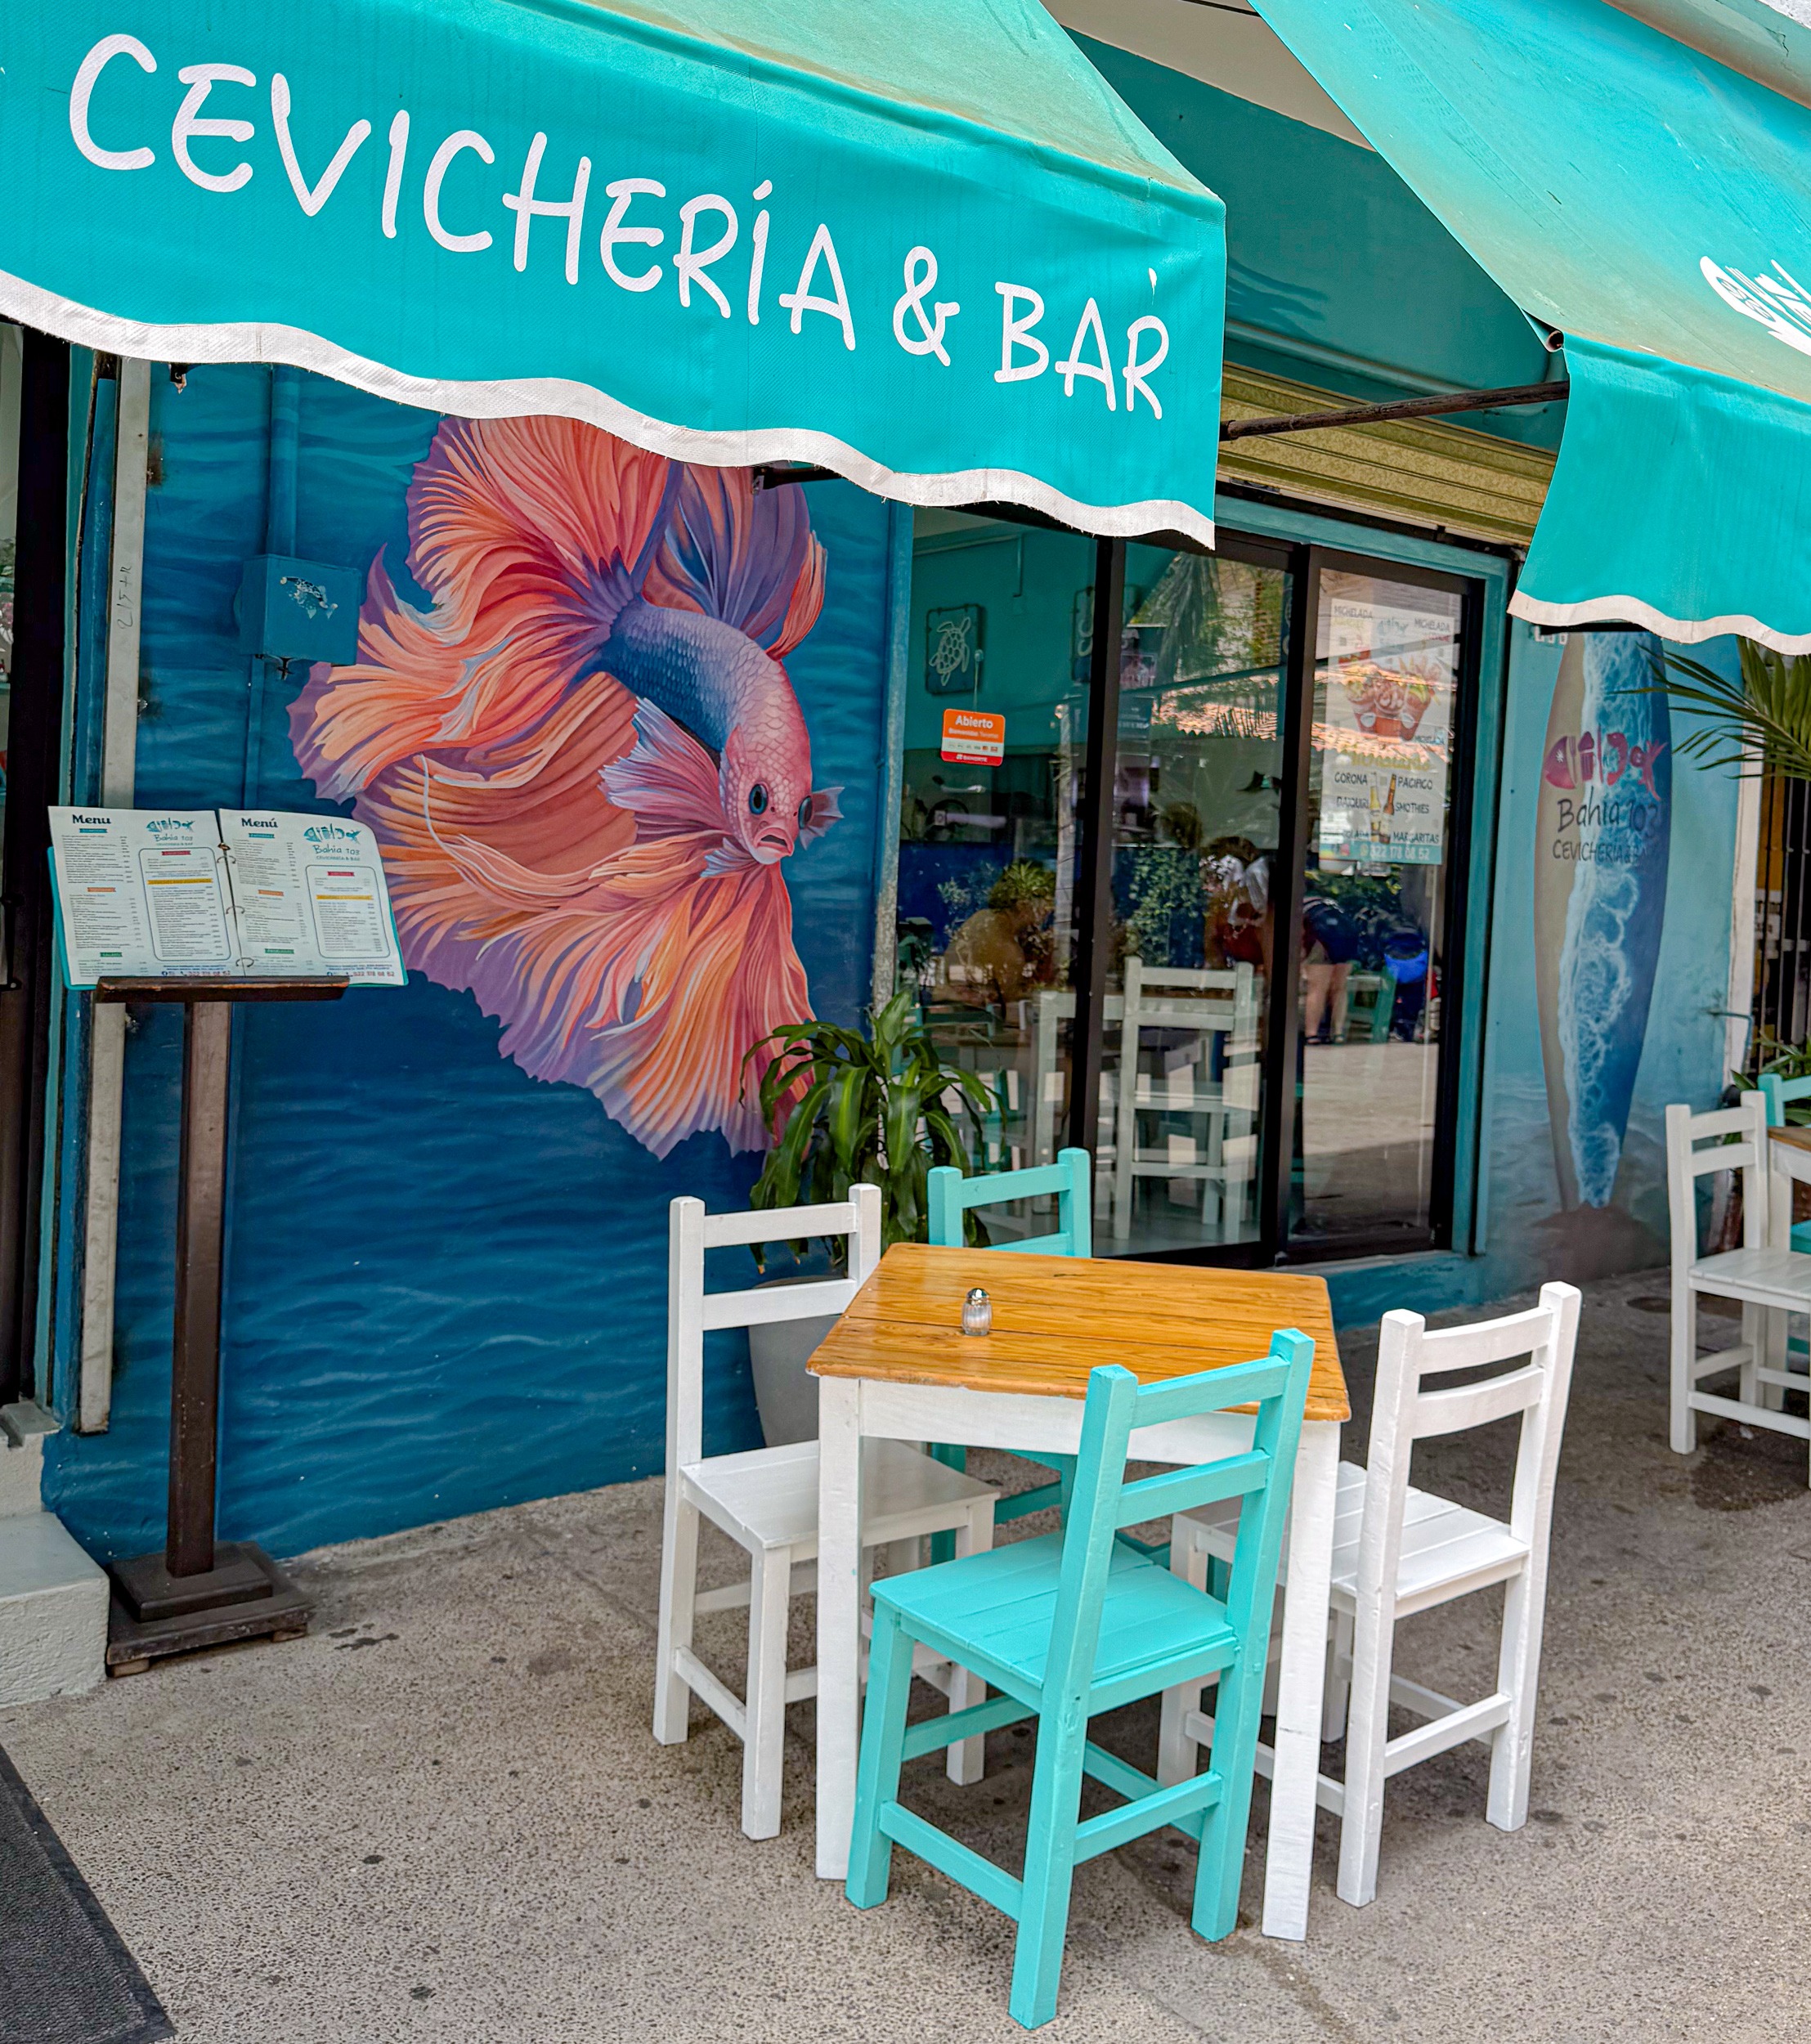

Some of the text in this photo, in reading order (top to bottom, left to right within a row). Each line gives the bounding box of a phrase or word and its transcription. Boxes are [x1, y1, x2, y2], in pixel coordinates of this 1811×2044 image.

[69, 34, 1170, 419] CEVICHERÍA & BAR
[1334, 605, 1373, 619] MICHELADA
[1414, 618, 1450, 632] MICHELADA
[955, 715, 994, 729] Abierto
[1334, 772, 1368, 786] CORONA
[1397, 776, 1433, 791] PACIFICO
[72, 814, 112, 825] Menu
[241, 818, 279, 828] Menú
